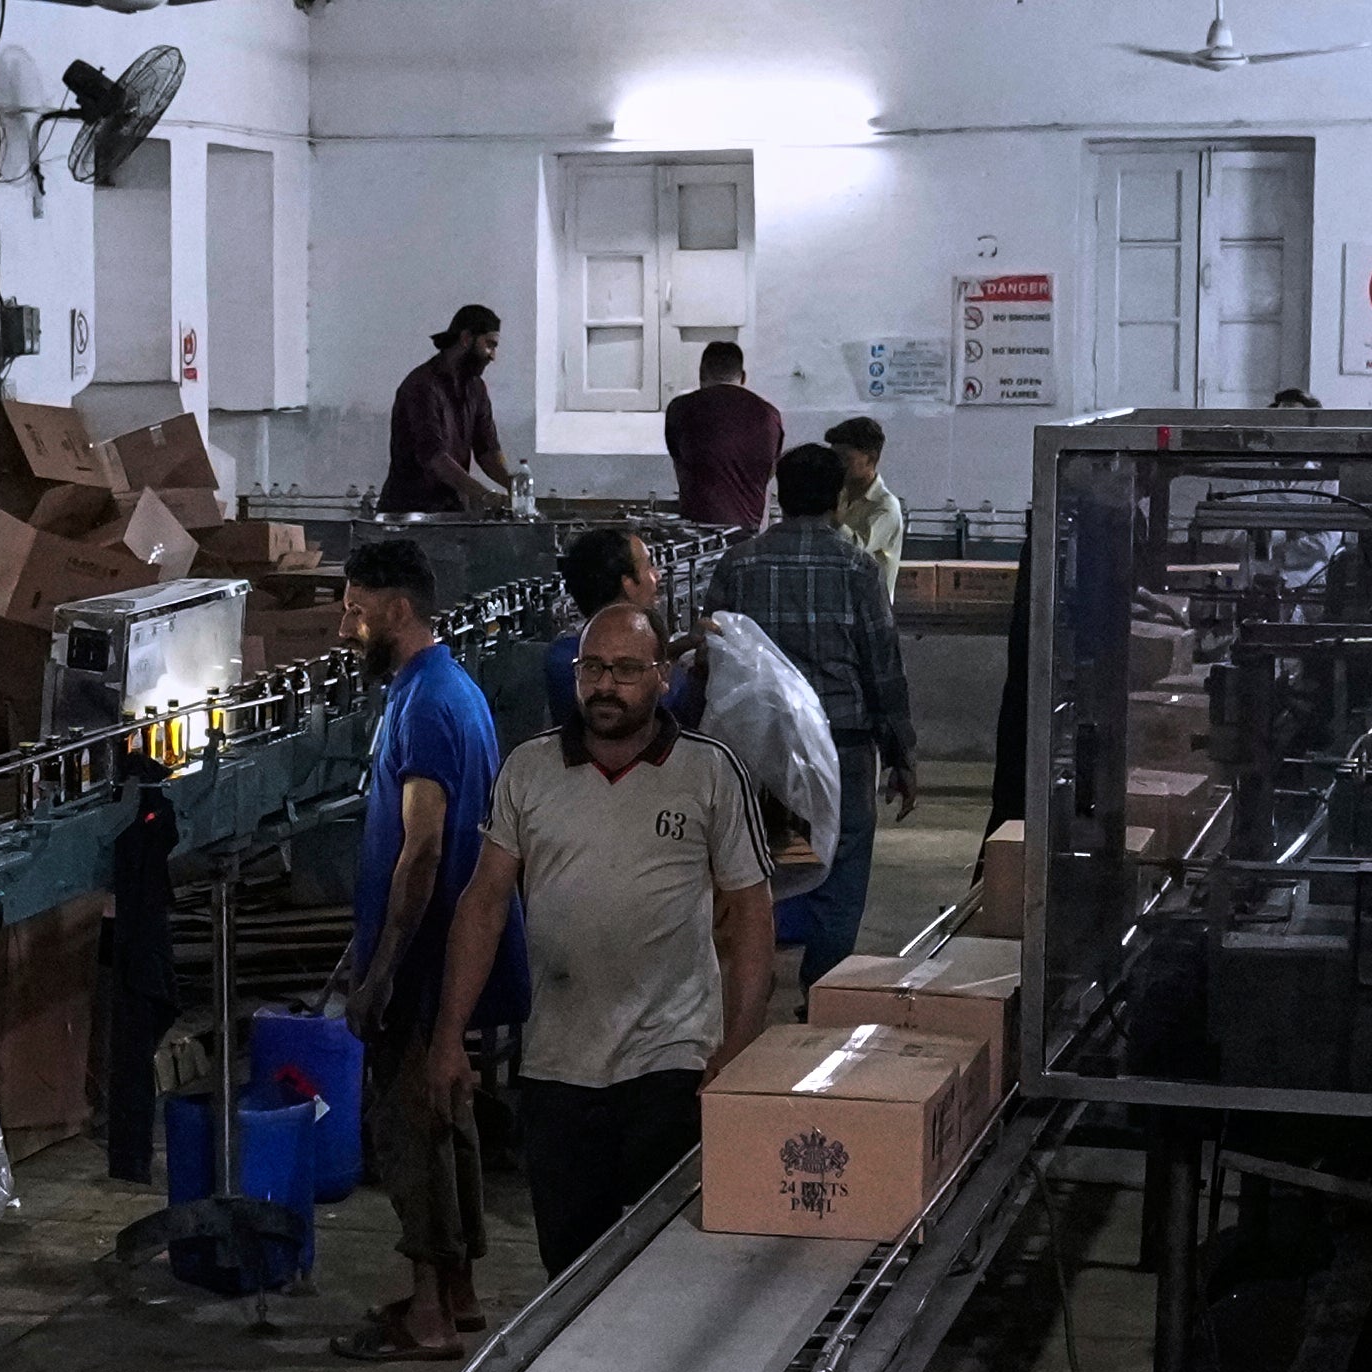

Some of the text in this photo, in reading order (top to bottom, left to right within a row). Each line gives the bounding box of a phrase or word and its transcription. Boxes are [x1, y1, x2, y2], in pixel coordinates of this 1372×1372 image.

[987, 282, 1049, 296] DANGER
[992, 313, 1051, 321] NO SMOKING
[992, 347, 1050, 355] NO MATCHES
[999, 377, 1041, 386] NO OPEN
[655, 809, 687, 841] 63
[779, 1181, 849, 1198] 24 PINTS
